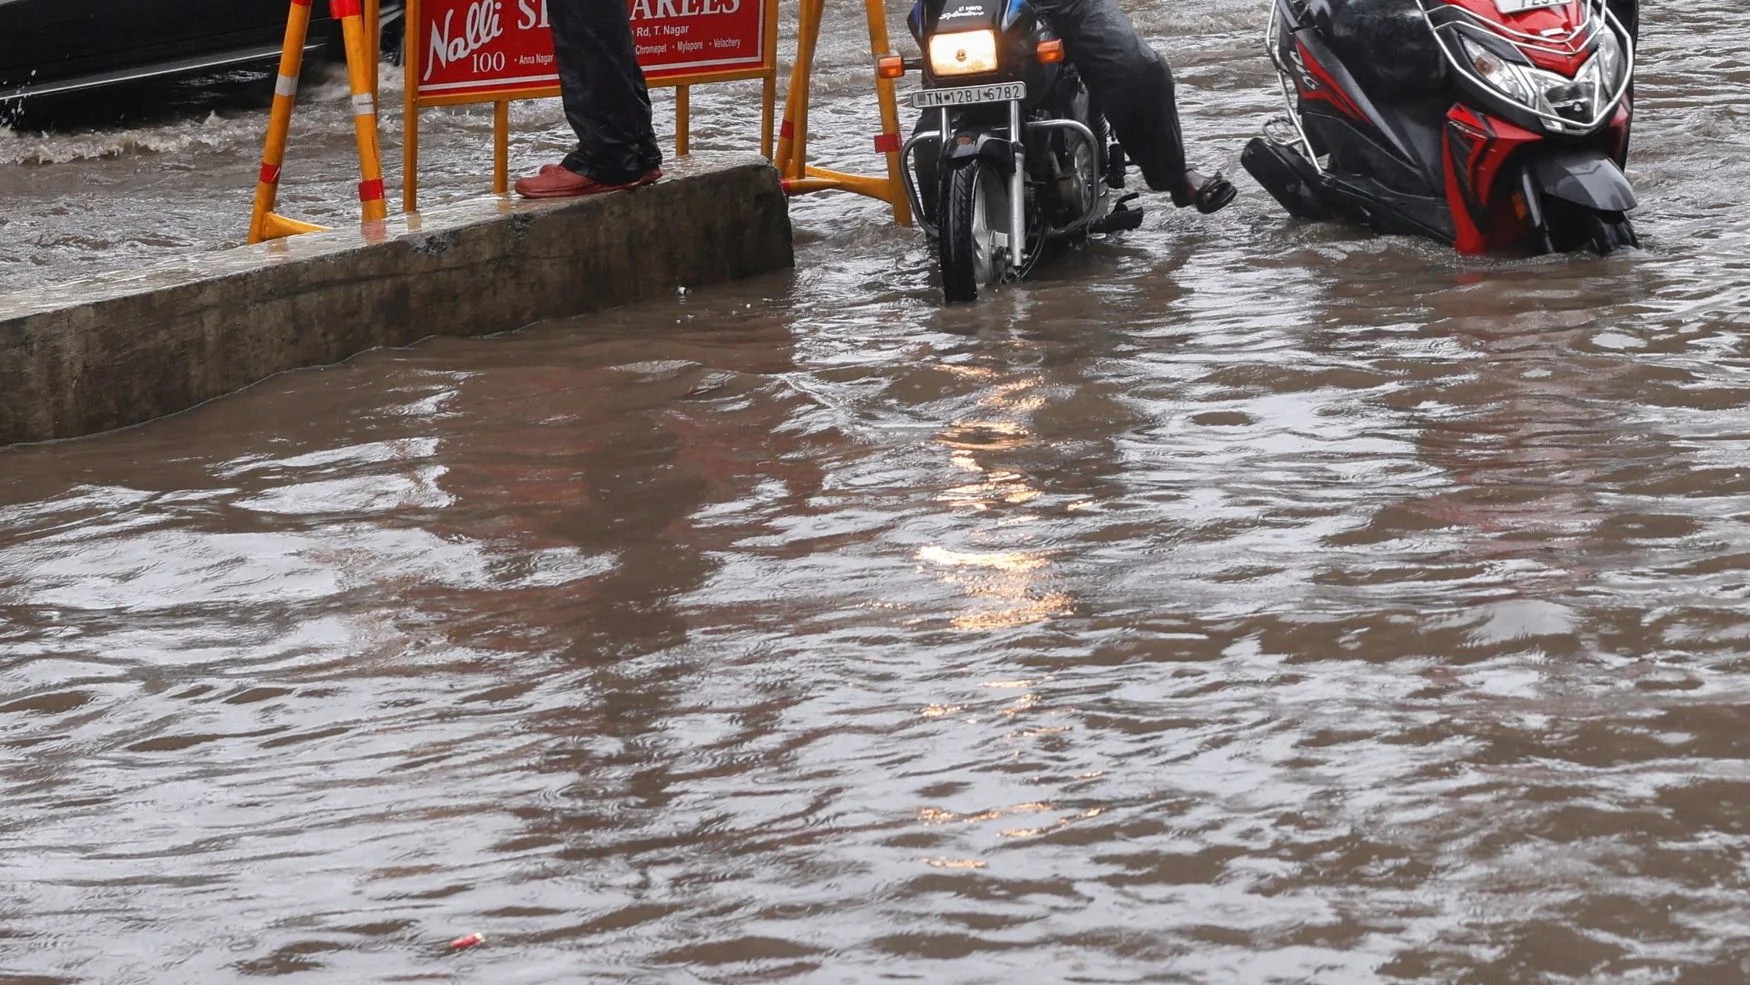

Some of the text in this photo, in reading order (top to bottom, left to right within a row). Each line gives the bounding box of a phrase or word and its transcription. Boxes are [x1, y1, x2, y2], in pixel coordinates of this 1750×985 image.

[636, 24, 689, 38] Rd, T. Nagar
[471, 37, 741, 74] 100 Anna Nagar Chromepet Mylapore Velachery
